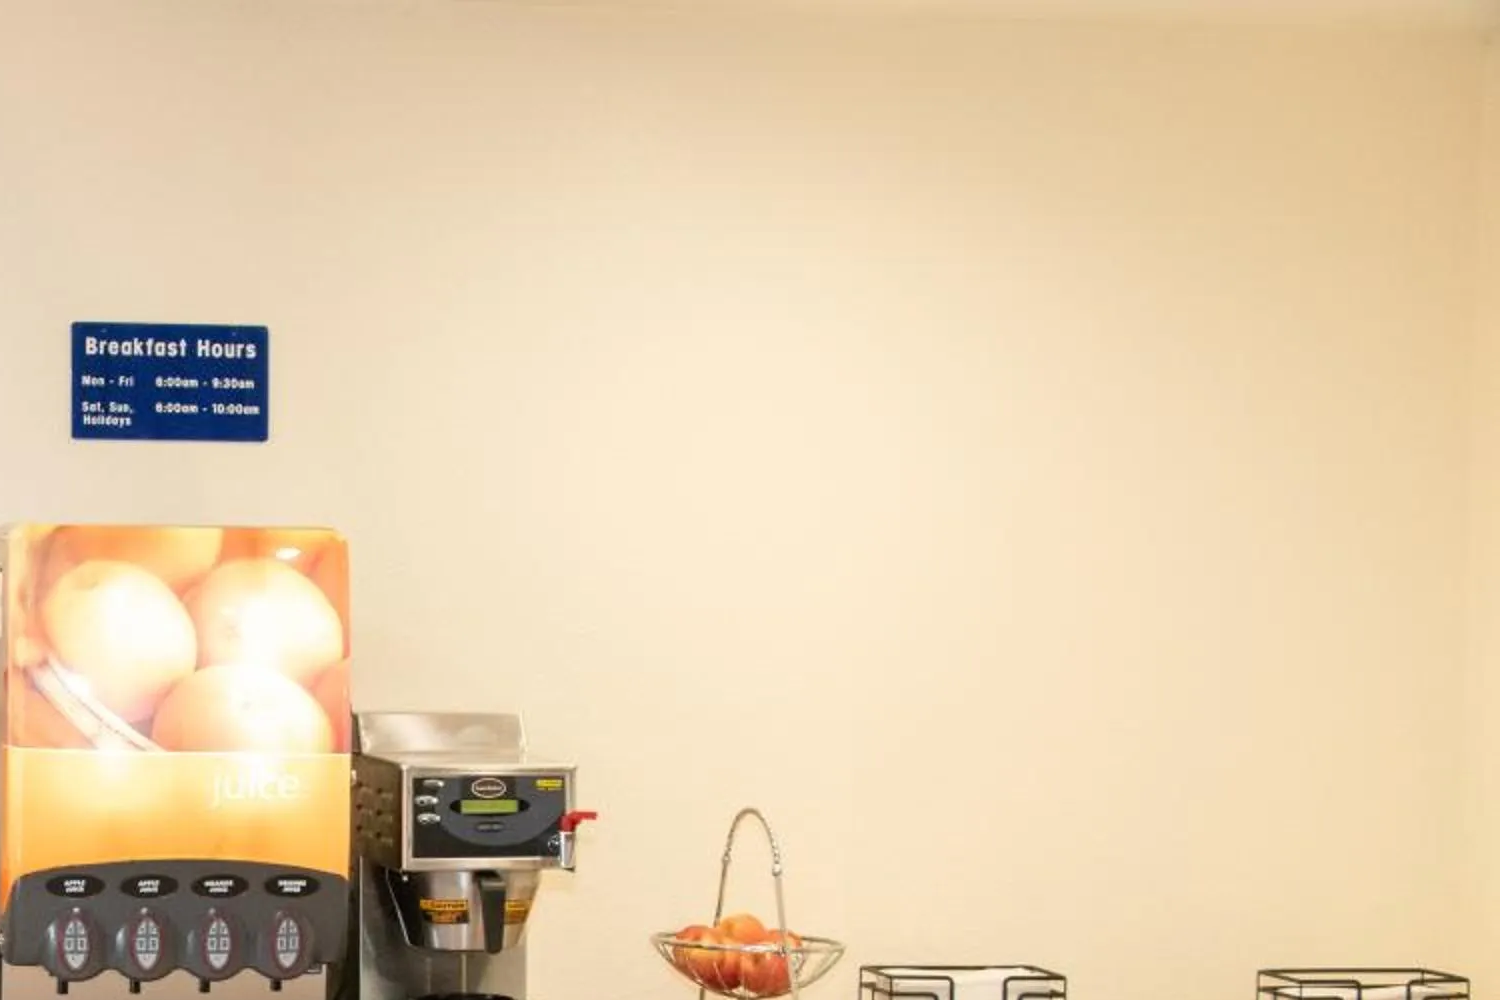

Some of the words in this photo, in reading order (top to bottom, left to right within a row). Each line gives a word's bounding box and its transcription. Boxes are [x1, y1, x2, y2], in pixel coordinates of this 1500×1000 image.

[84, 337, 187, 357] Breakfast
[197, 338, 257, 359] Hours
[81, 375, 105, 387] Mon
[118, 375, 135, 387] Fri
[83, 414, 132, 428] Holidays
